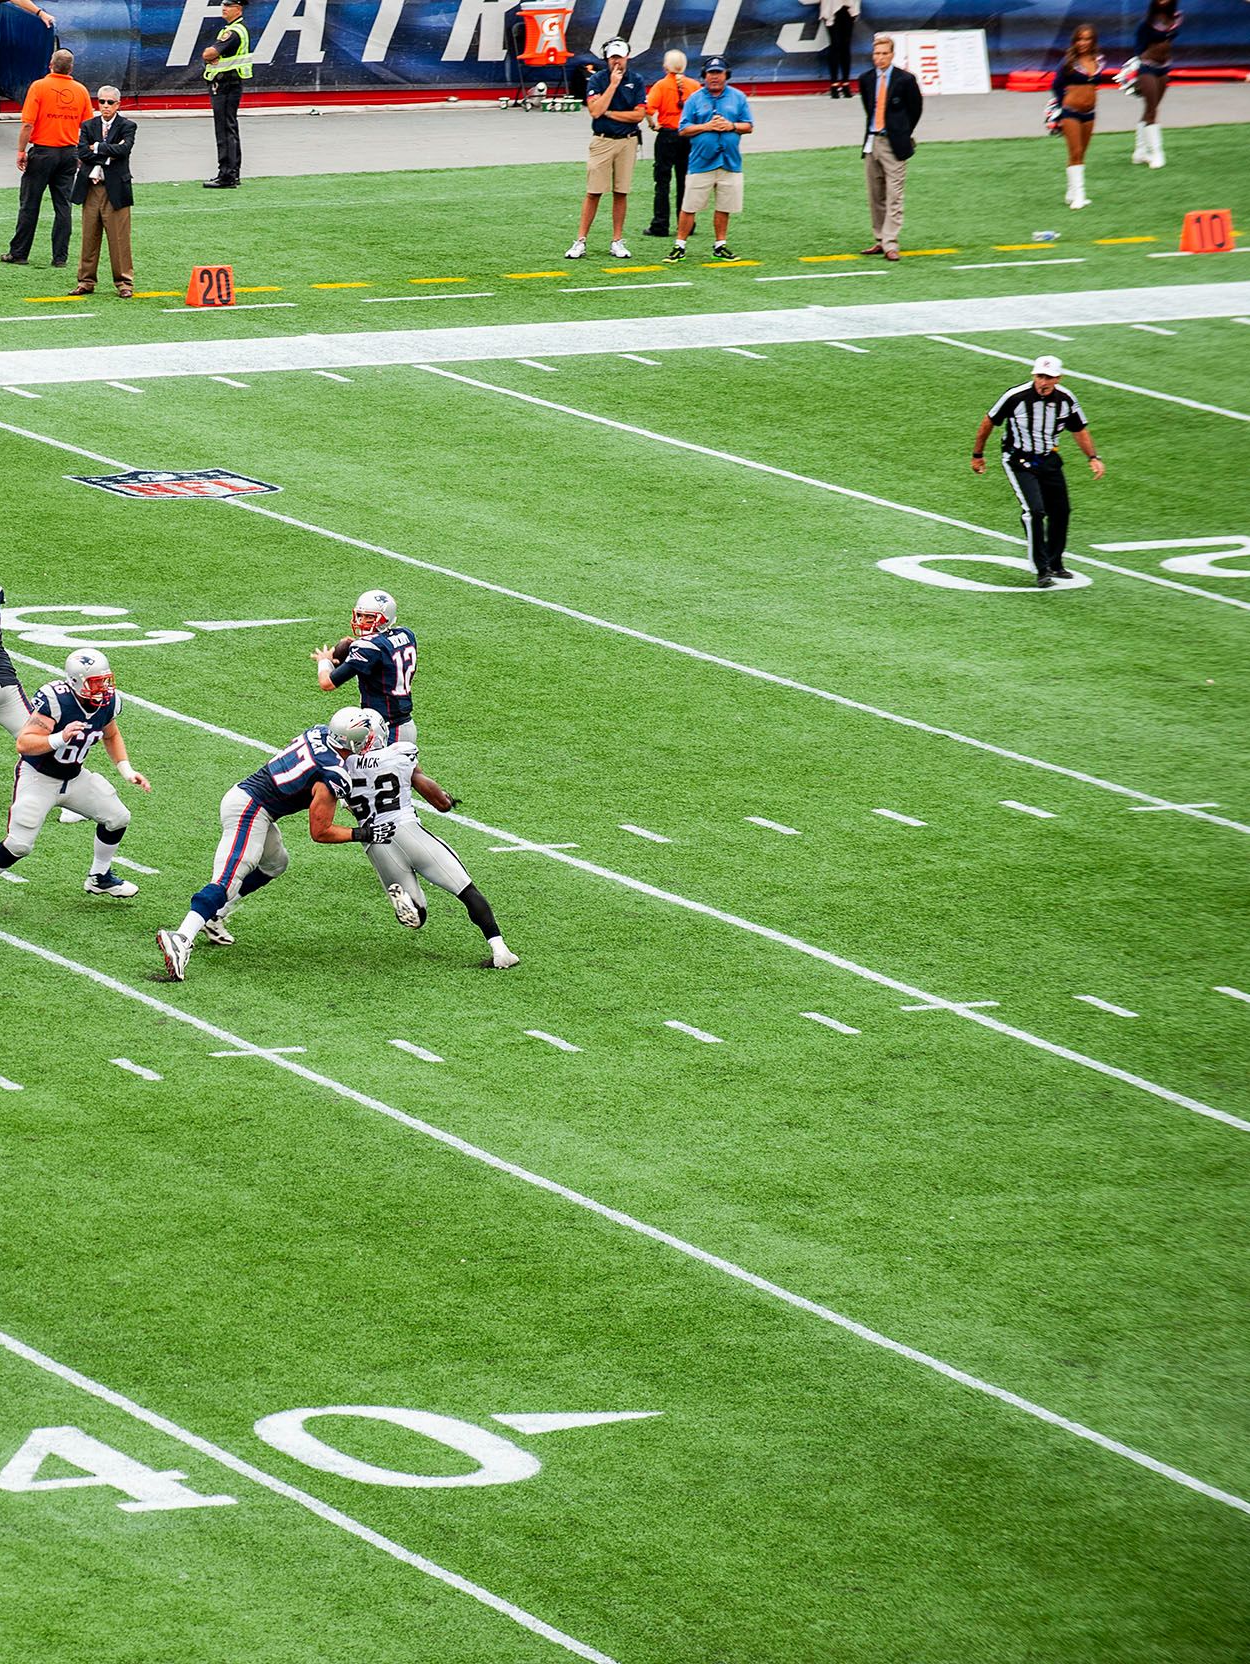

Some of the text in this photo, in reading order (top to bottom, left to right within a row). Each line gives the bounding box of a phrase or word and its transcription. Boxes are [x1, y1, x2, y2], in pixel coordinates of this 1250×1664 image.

[1195, 214, 1225, 249] 10
[200, 268, 231, 304] 20
[391, 645, 418, 696] 12
[355, 756, 380, 770] MACK
[350, 772, 401, 822] 52
